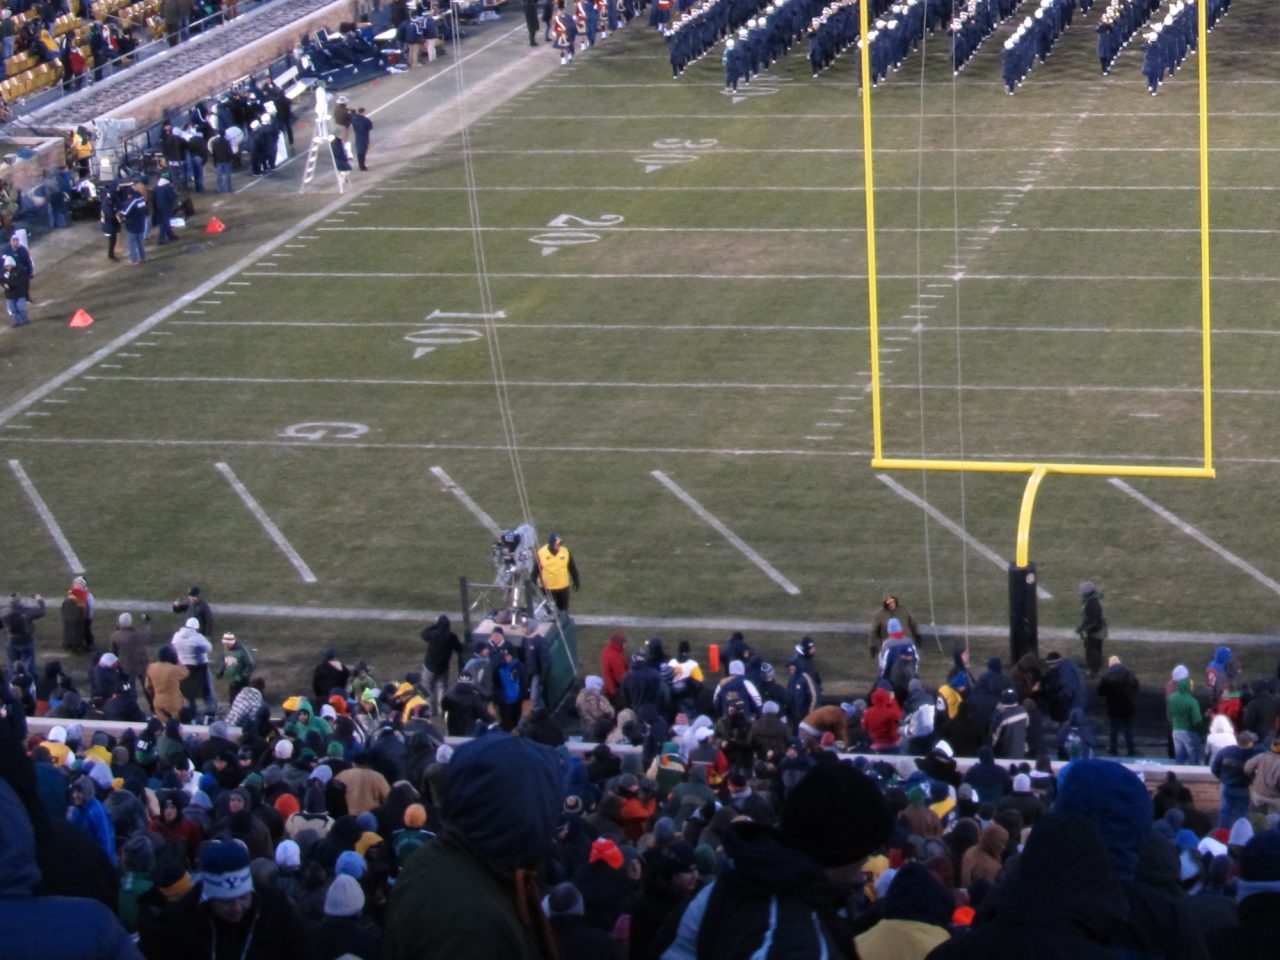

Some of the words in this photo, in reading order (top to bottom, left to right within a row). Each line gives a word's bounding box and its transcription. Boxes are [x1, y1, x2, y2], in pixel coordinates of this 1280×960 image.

[529, 214, 625, 246] 20
[404, 309, 507, 344] 10
[277, 421, 370, 440] G
